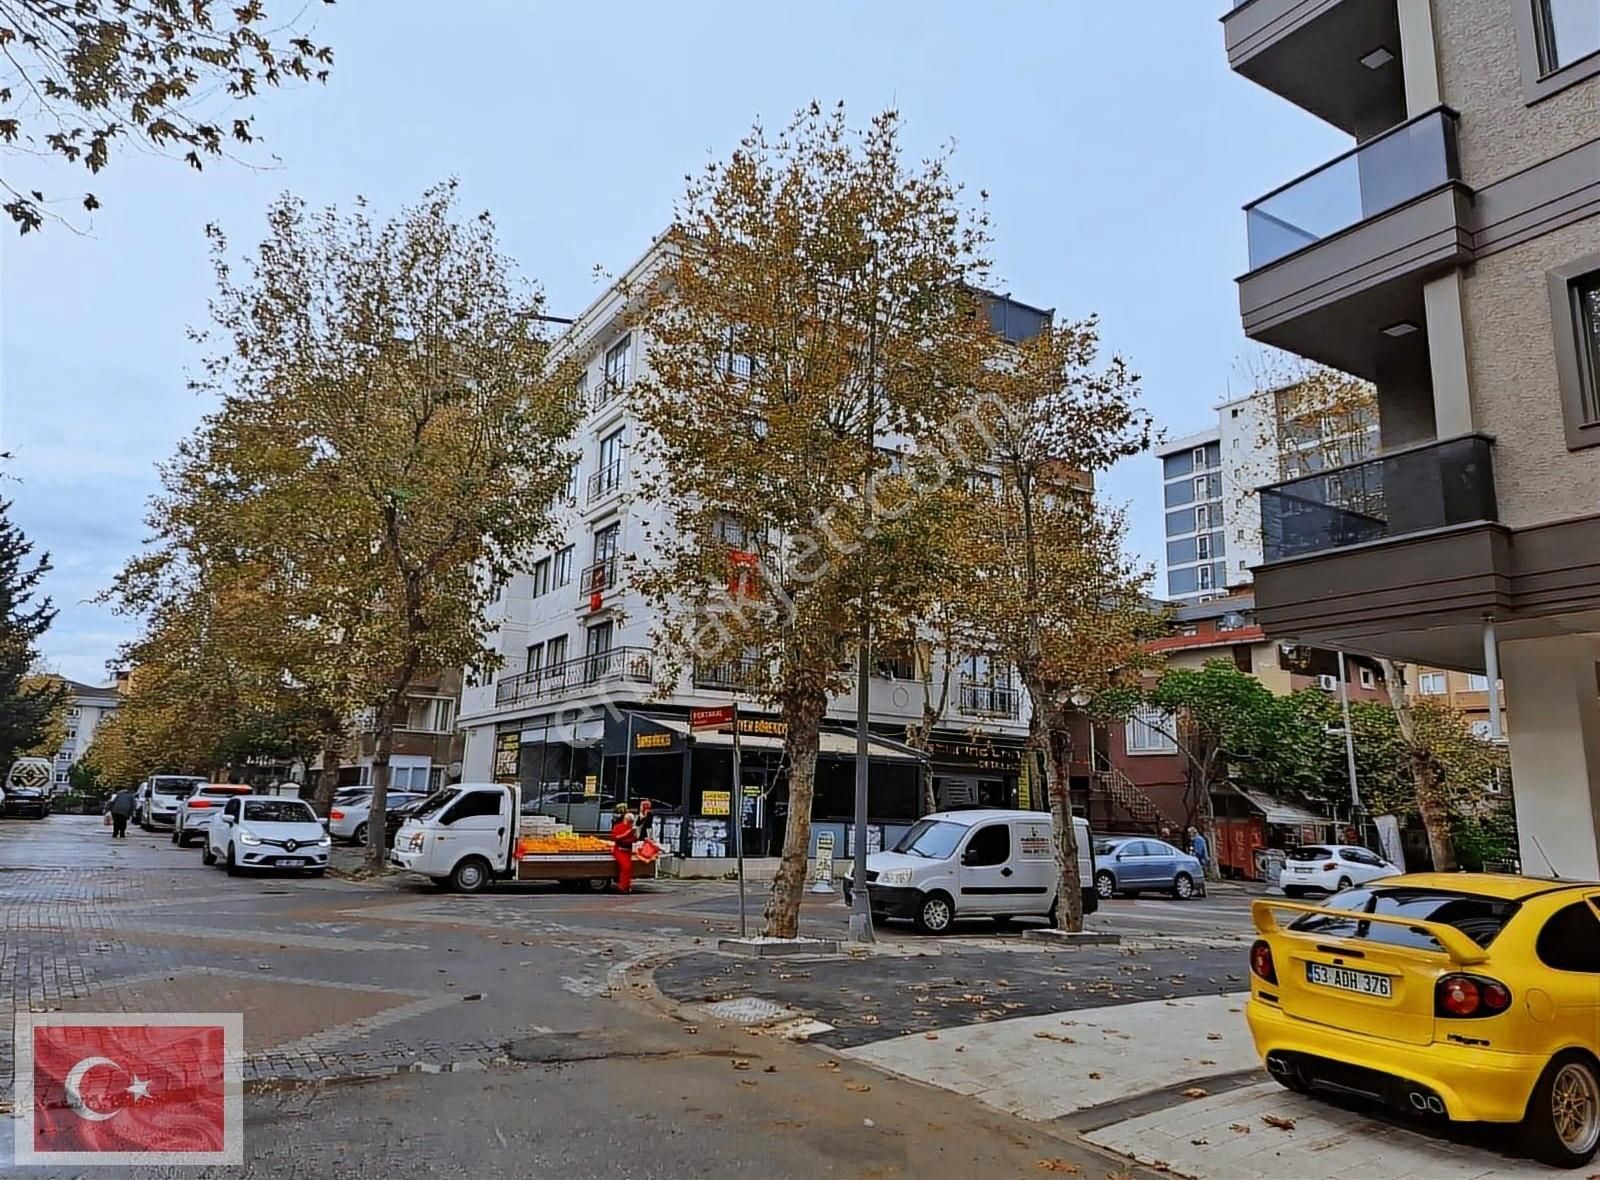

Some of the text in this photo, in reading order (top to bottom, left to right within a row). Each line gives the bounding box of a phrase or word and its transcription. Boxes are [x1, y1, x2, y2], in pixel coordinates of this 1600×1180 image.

[1313, 964, 1389, 995] 53 ADH 376
